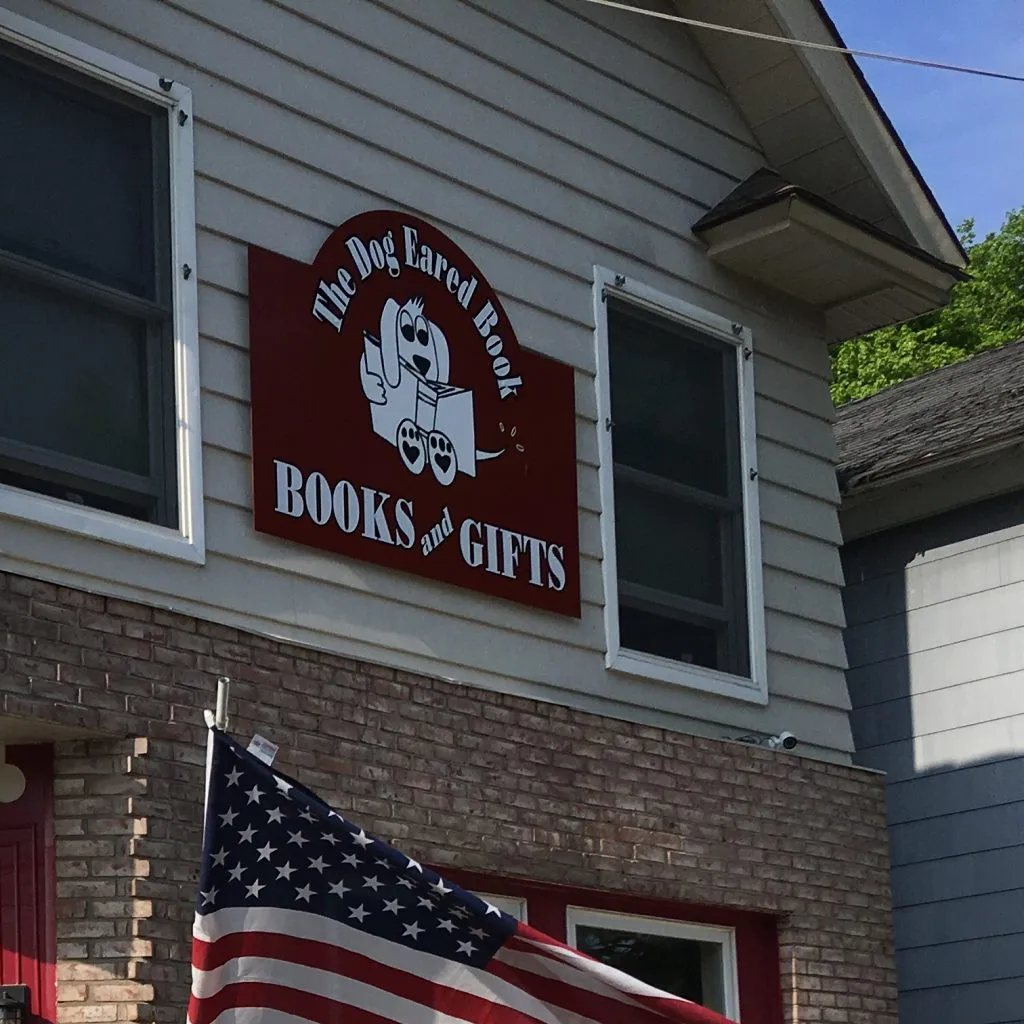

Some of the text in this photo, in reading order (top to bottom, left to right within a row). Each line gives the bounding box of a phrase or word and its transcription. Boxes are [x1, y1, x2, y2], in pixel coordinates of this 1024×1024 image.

[312, 225, 522, 399] The Dog Eared Book
[273, 460, 566, 591] BOOKS and GIFTS
